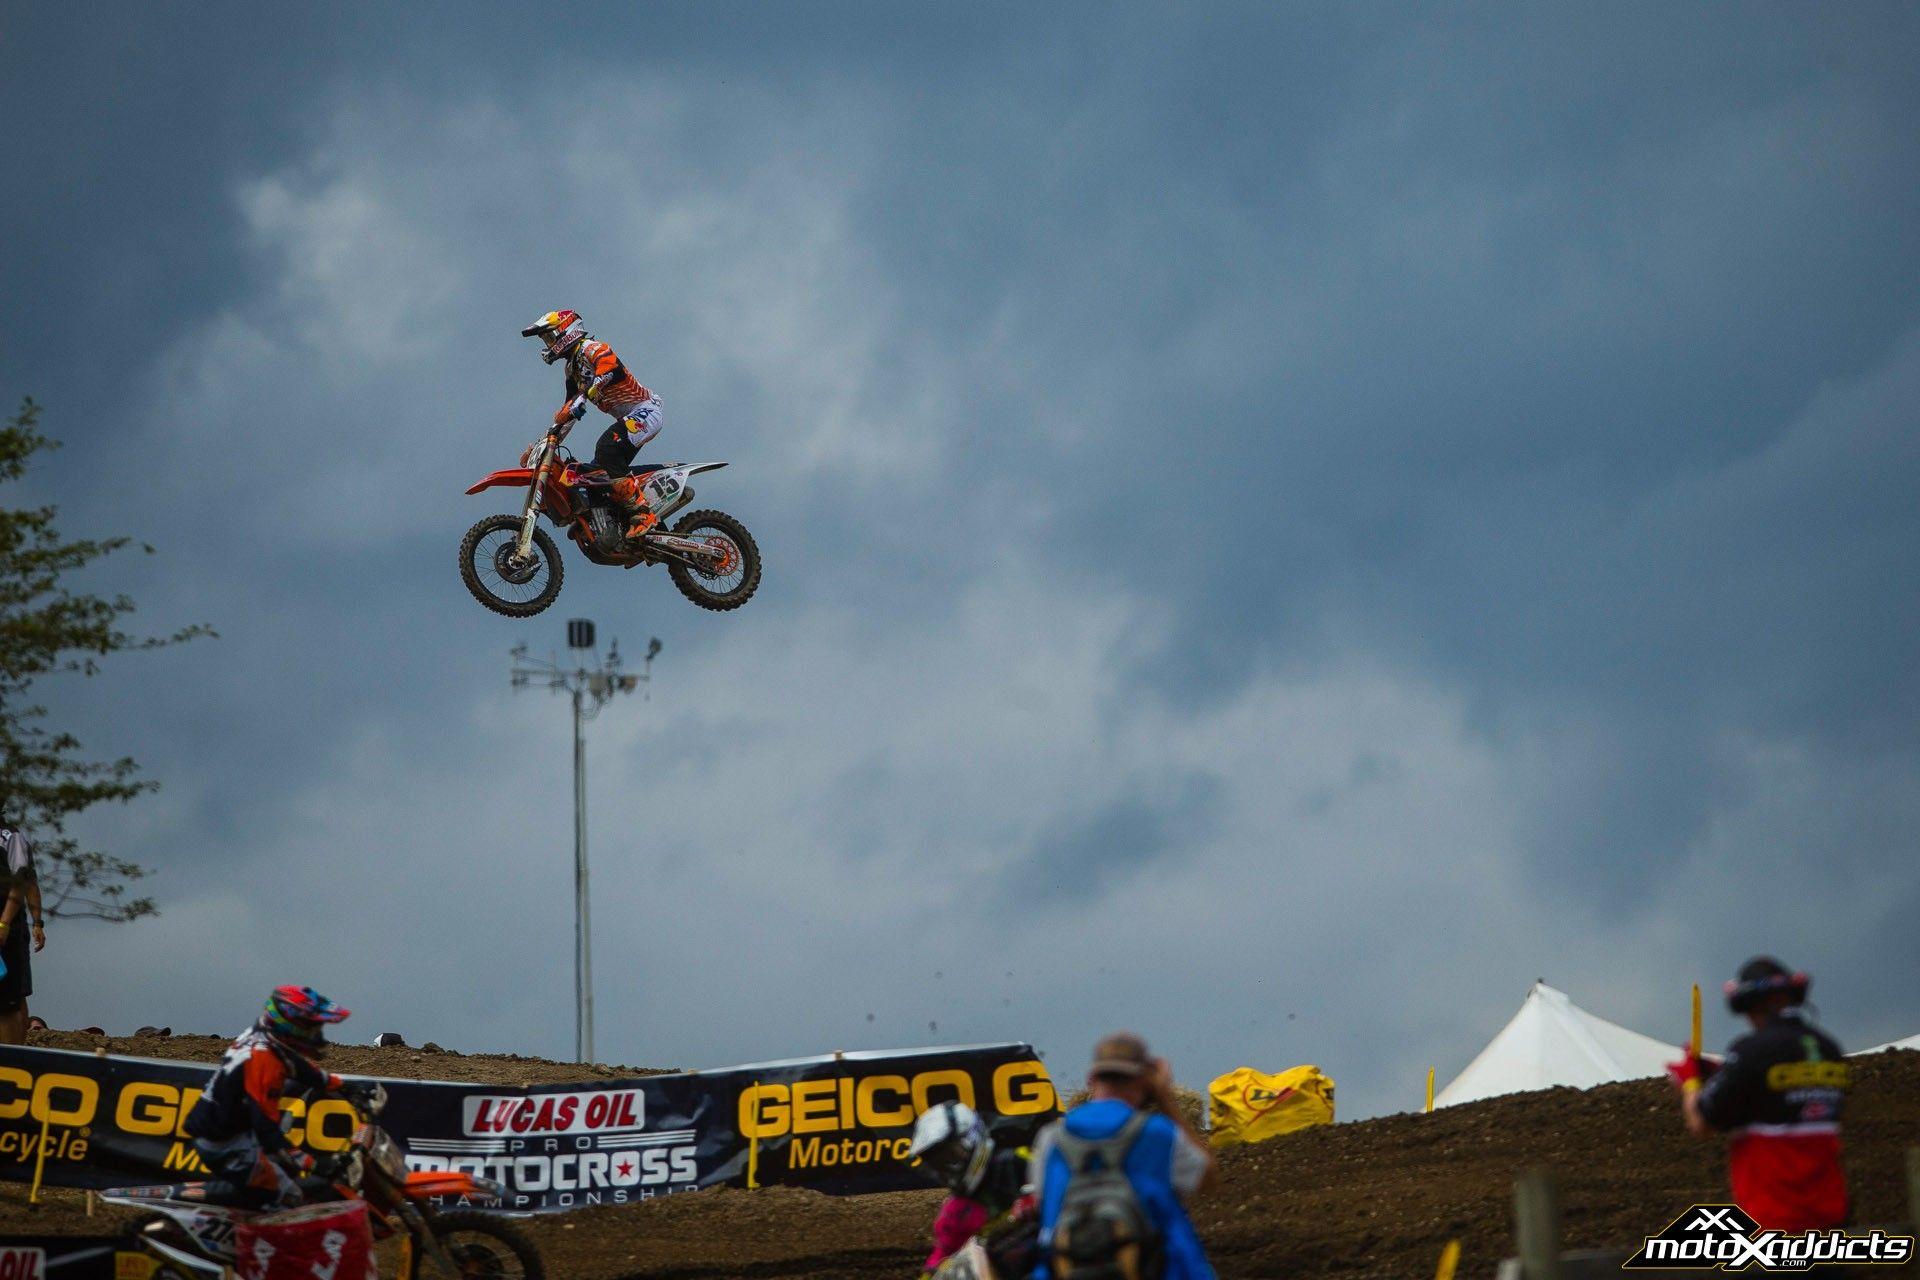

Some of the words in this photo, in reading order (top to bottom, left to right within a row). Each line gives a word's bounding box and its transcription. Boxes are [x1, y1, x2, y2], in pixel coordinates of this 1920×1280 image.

[649, 475, 680, 498] 15
[471, 1095, 579, 1133] LUCAS
[585, 1092, 637, 1129] OIL
[739, 1069, 976, 1138] GEICO
[510, 1136, 591, 1151] PRO
[788, 1136, 922, 1169] Motorc
